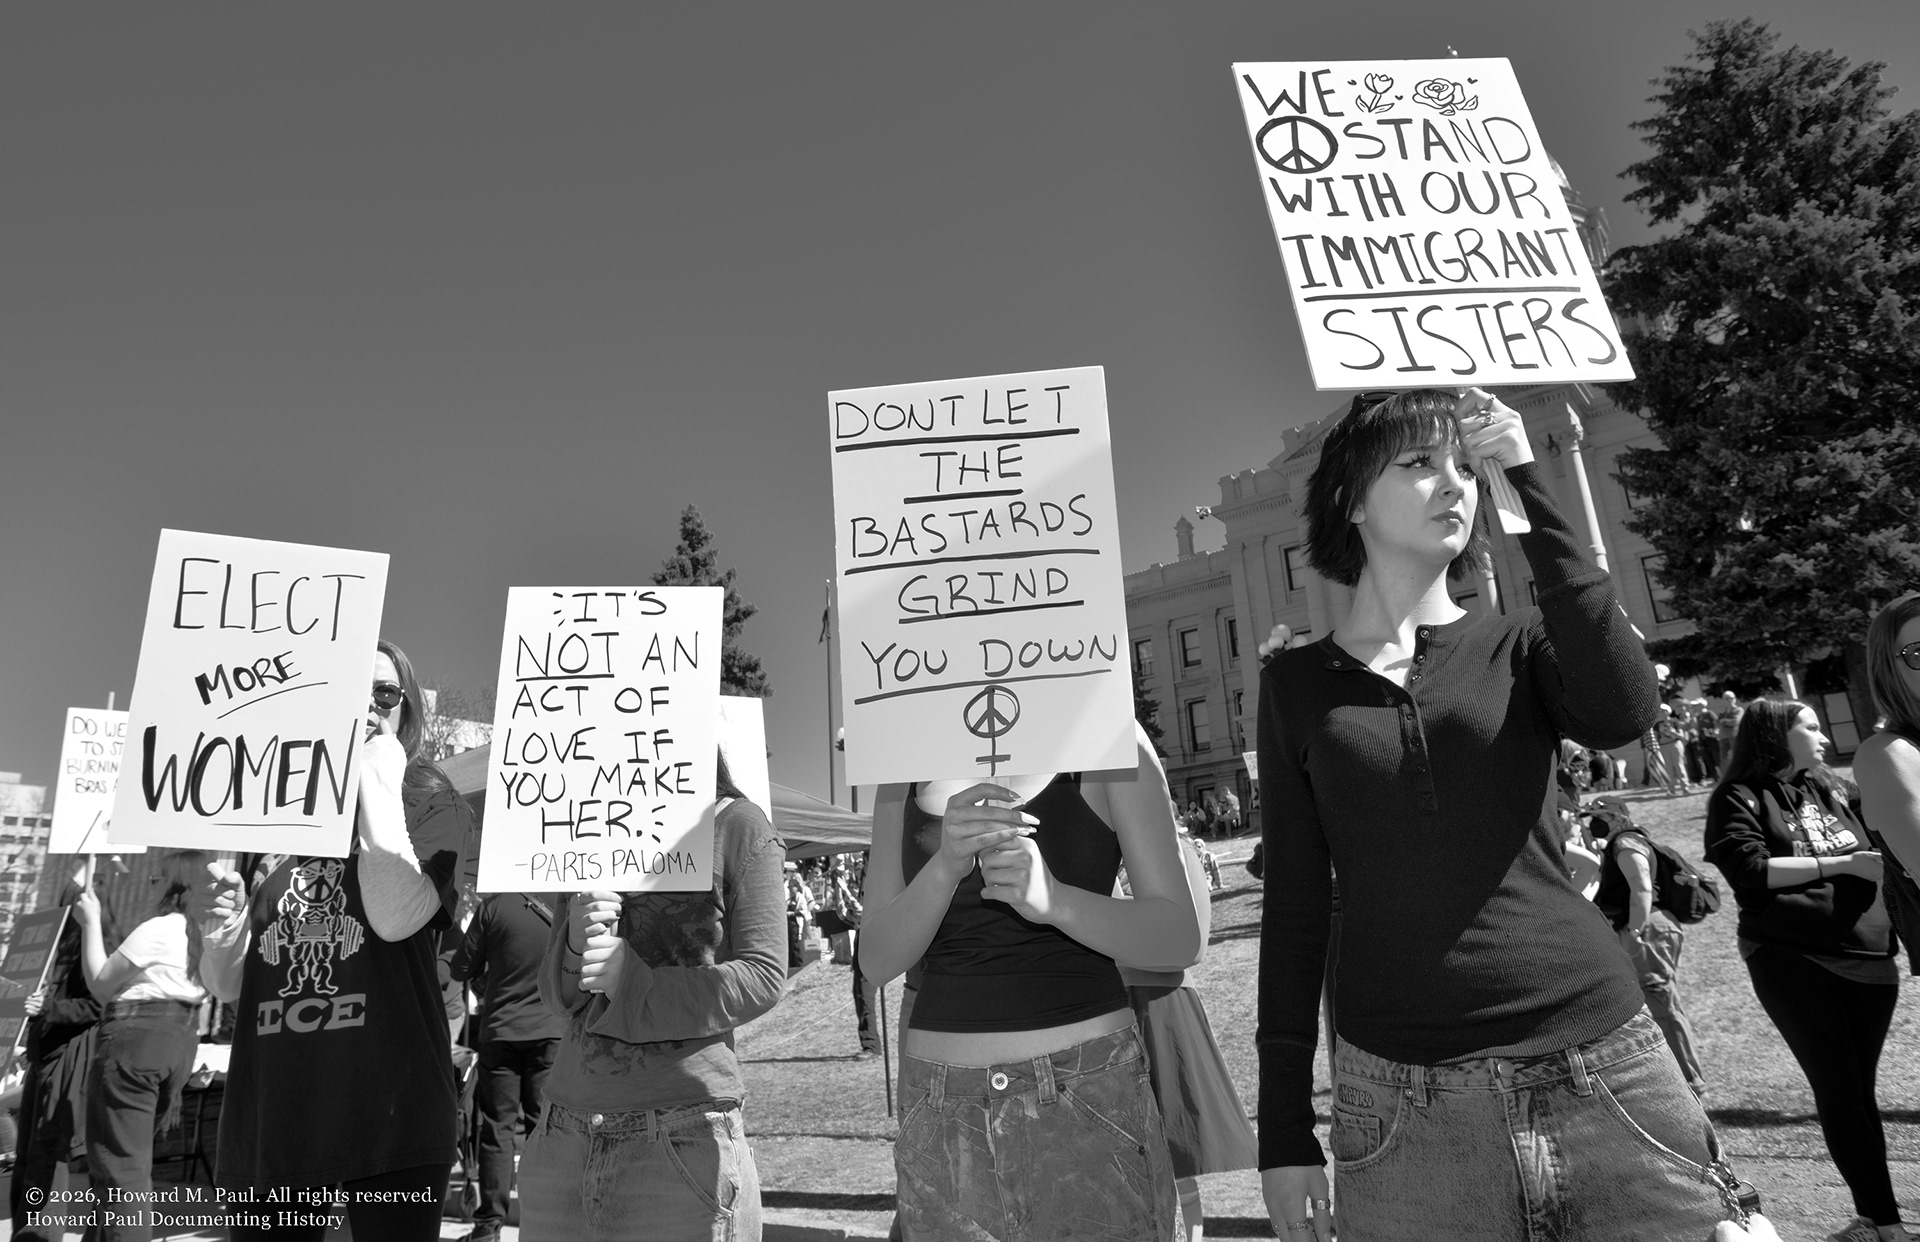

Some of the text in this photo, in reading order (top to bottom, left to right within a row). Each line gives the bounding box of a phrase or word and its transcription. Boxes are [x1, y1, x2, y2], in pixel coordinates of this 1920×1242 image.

[1242, 69, 1345, 118] WE
[1343, 115, 1531, 166] STAND
[1269, 171, 1551, 222] WITH OUR
[1282, 227, 1578, 289] IMMIGRANT
[1322, 297, 1618, 376] SISTERS
[836, 385, 1070, 439] DONT LET
[919, 443, 1023, 492] THE
[851, 493, 1094, 558] BASTARDS
[172, 557, 366, 642] ELECT
[572, 590, 667, 623] IT'S
[897, 567, 1071, 617] GRIND
[516, 630, 699, 677] NOT AN
[861, 634, 1117, 690] YOU DOWN
[194, 651, 303, 706] MORE
[511, 683, 670, 720] ACT OF
[72, 715, 98, 736] DO
[80, 740, 124, 756] TO ST
[502, 726, 674, 766] LOVE IF
[66, 758, 119, 775] BURNIN
[75, 777, 107, 794] BRAS
[141, 718, 359, 818] WOMEN
[499, 762, 696, 810] YOU MAKE
[541, 797, 643, 845] HER.
[611, 849, 697, 878] PALOMA
[257, 992, 366, 1036] ICE
